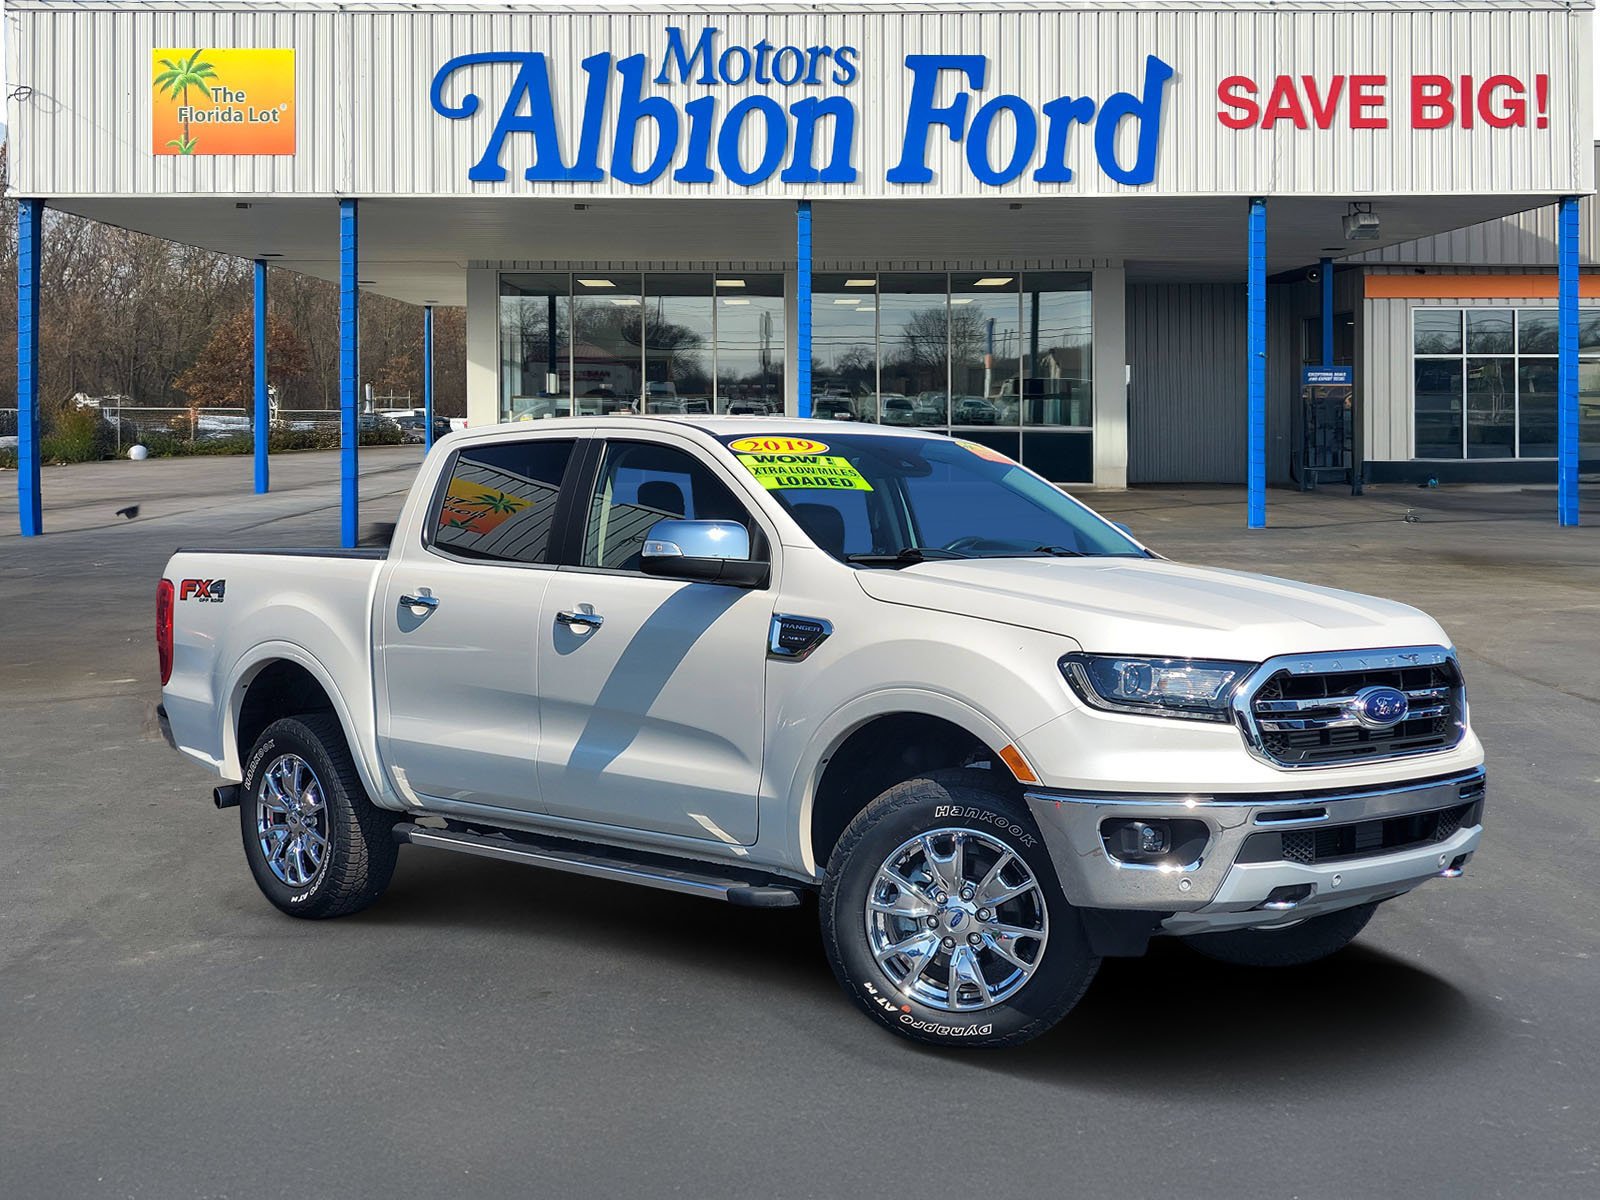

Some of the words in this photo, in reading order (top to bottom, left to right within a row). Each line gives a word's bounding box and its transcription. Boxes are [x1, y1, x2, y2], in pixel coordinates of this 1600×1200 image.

[653, 27, 857, 86] Motors
[211, 87, 245, 103] The
[1217, 75, 1388, 130] SAVE
[1411, 74, 1549, 130] BIG!
[177, 106, 243, 122] Florida
[248, 106, 278, 122] Lot
[430, 51, 857, 186] Albion
[886, 54, 1174, 187] Ford
[744, 440, 814, 451] 2019
[752, 455, 817, 464] WOW
[752, 466, 787, 476] XTRA
[789, 466, 816, 475] LOW
[817, 467, 857, 478] MILES
[776, 476, 854, 488] LOADED
[180, 579, 226, 600] FX4
[782, 623, 820, 632] RANGER
[899, 1014, 993, 1037] Dynapro
